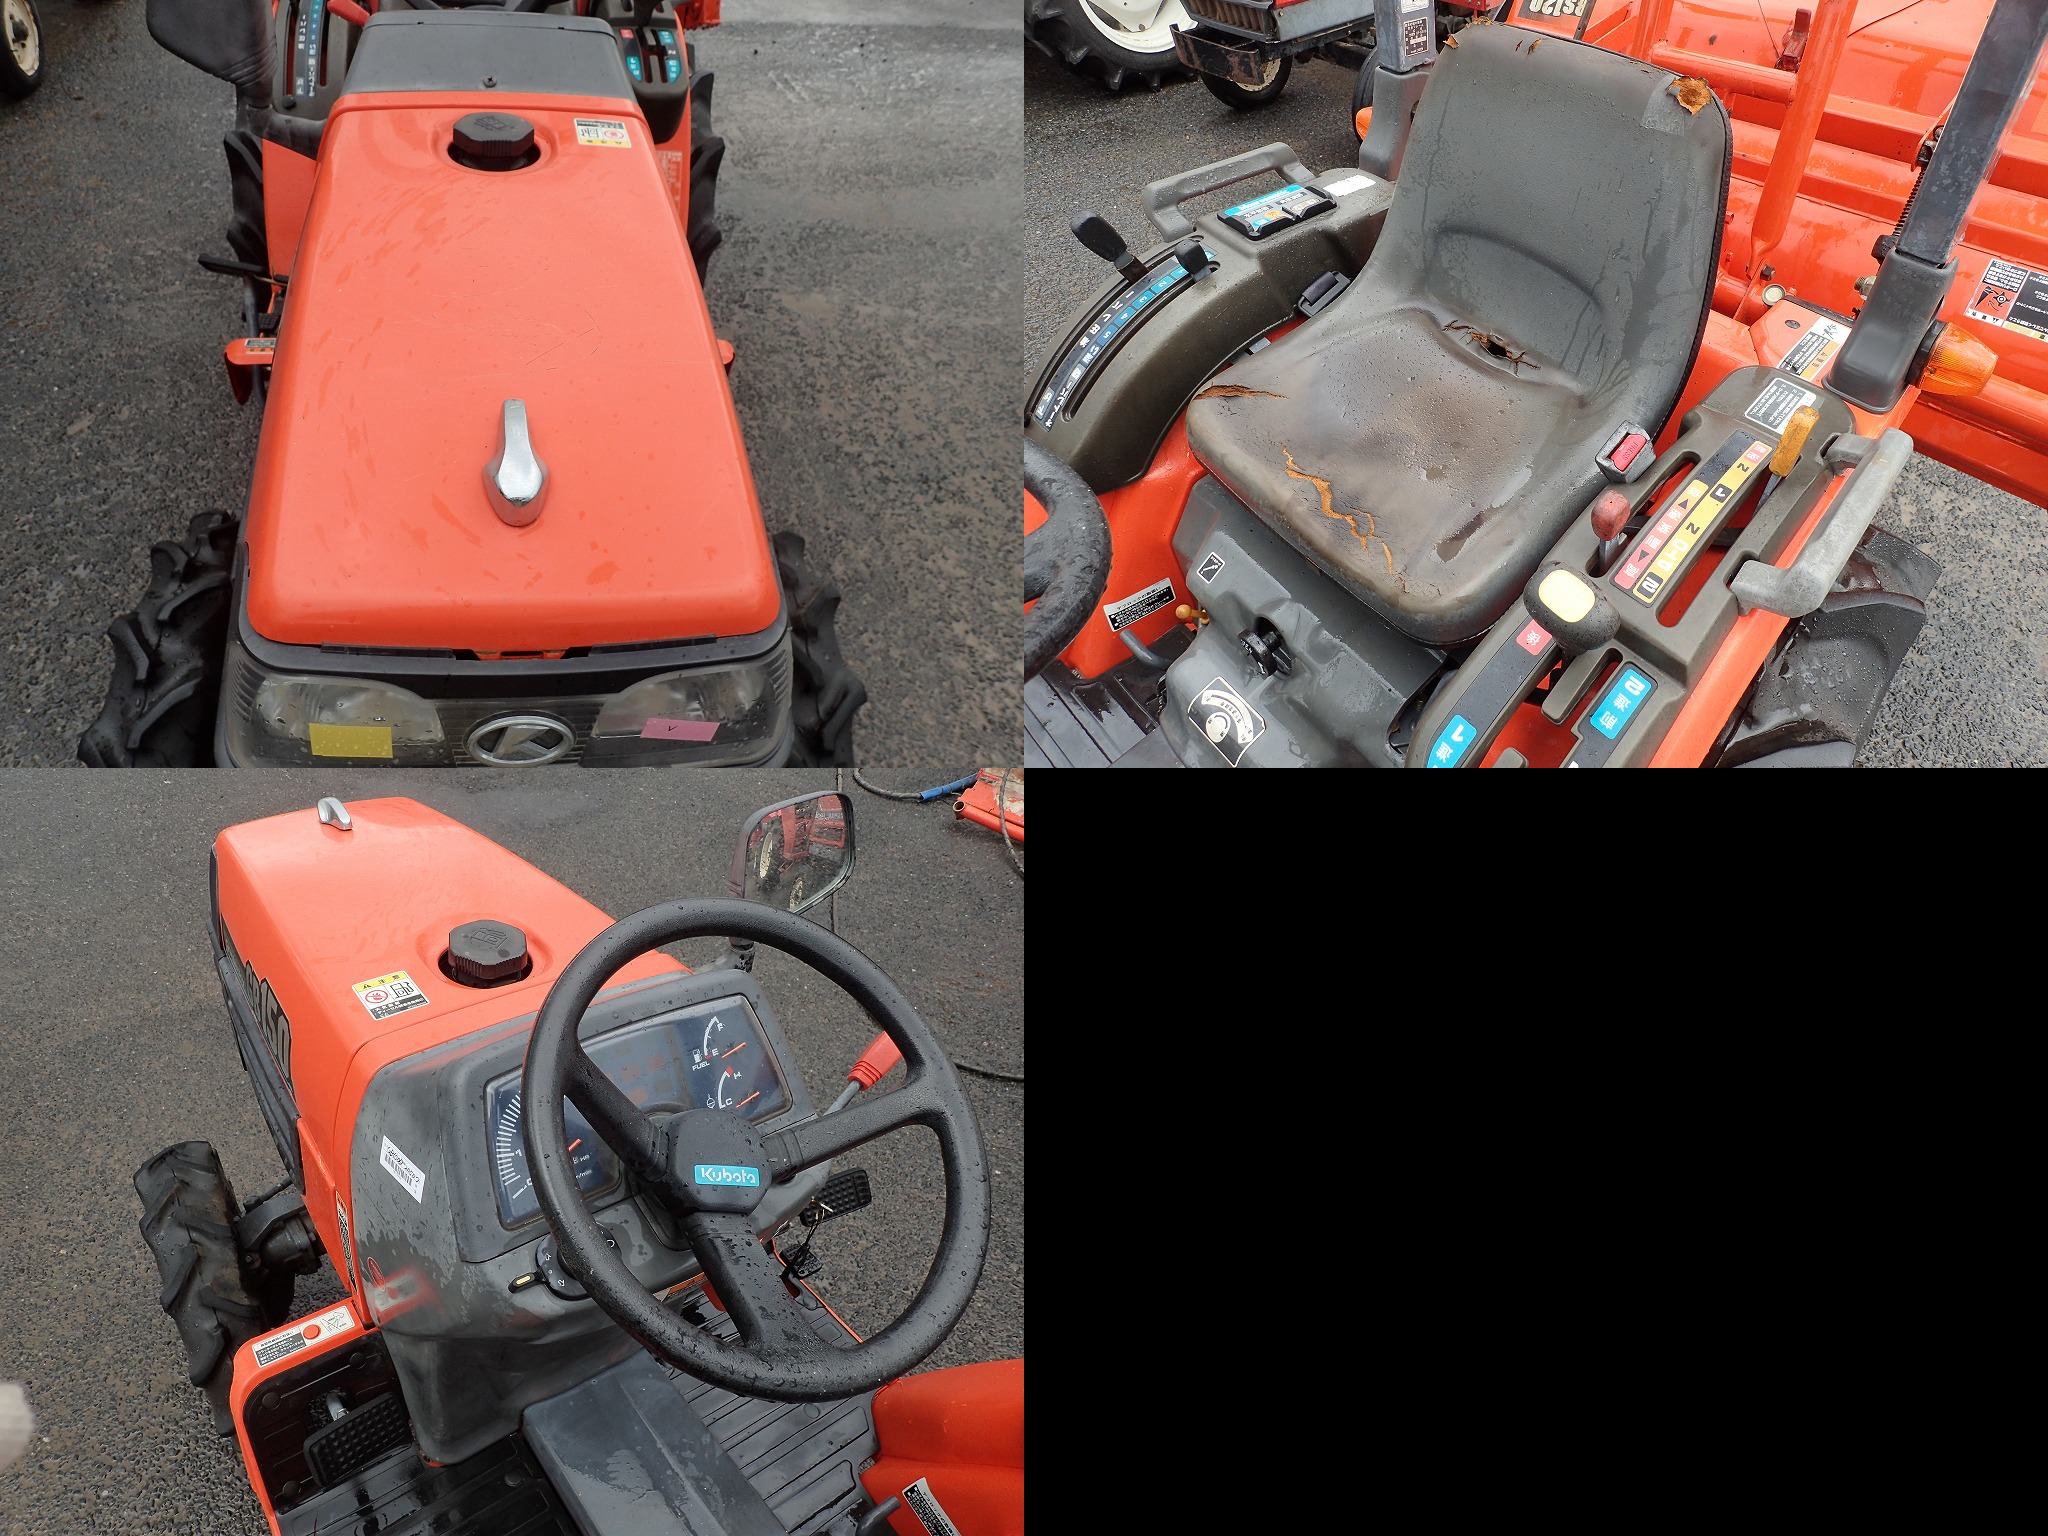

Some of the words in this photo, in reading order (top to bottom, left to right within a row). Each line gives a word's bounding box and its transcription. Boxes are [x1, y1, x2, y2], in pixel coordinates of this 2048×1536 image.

[1159, 280, 1167, 288] 2
[1079, 290, 1135, 348] 油圧レバー
[1103, 331, 1111, 339] 5
[1045, 381, 1074, 428] オートレバー
[1737, 463, 1750, 473] N
[1715, 488, 1728, 498] 1
[1685, 522, 1701, 535] N
[1659, 537, 1690, 571] PTO
[1641, 577, 1660, 594] 2
[1525, 630, 1541, 646] 後
[1599, 675, 1646, 731] 前進2
[1432, 724, 1464, 768] 進1
[717, 1022, 725, 1031] F
[712, 1048, 719, 1056] E
[692, 1062, 710, 1071] FUEL
[733, 1071, 742, 1080] H
[700, 1167, 756, 1185] Kubota
